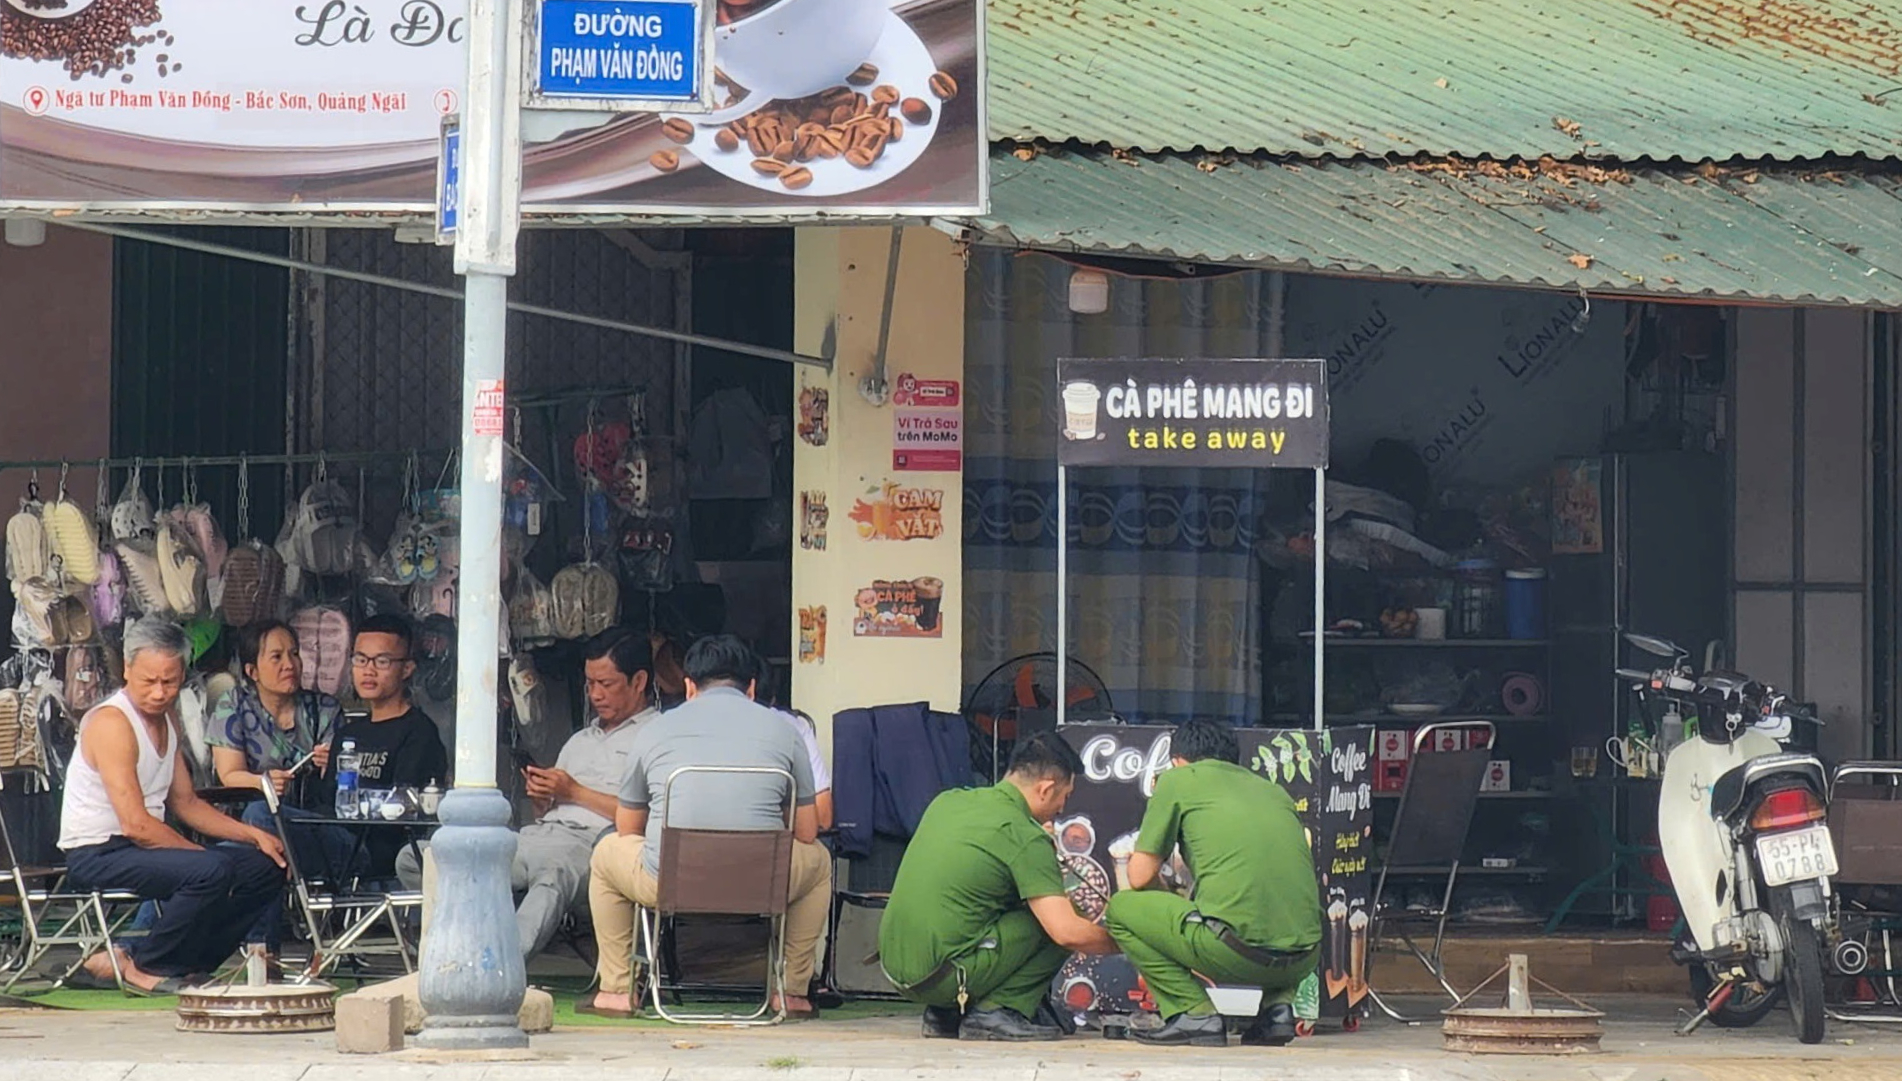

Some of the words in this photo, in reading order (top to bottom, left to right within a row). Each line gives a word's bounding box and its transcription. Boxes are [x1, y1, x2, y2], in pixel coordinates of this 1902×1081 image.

[294, 0, 375, 47] Là
[573, 7, 663, 38] ĐƯỜNG
[551, 47, 597, 86] PHẠM
[600, 42, 634, 80] VĂN
[55, 89, 84, 111] Ngã
[89, 91, 106, 107] tư
[109, 89, 153, 110] Phạm
[318, 91, 367, 113] Quảng
[1327, 308, 1388, 376] ONALU
[1105, 377, 1142, 419] CÀ
[1146, 377, 1198, 419] PHÊ
[1203, 385, 1281, 419] MANG
[1285, 386, 1313, 419] ĐI
[922, 431, 958, 442] MoMo
[934, 417, 958, 429] Sau
[1127, 426, 1197, 449] take
[1207, 430, 1286, 455] away
[1422, 397, 1487, 463] ONALU
[893, 489, 943, 510] CAM
[1082, 734, 1174, 798] Cof
[1331, 742, 1367, 782] Coffee
[1774, 853, 1825, 881] 0788
